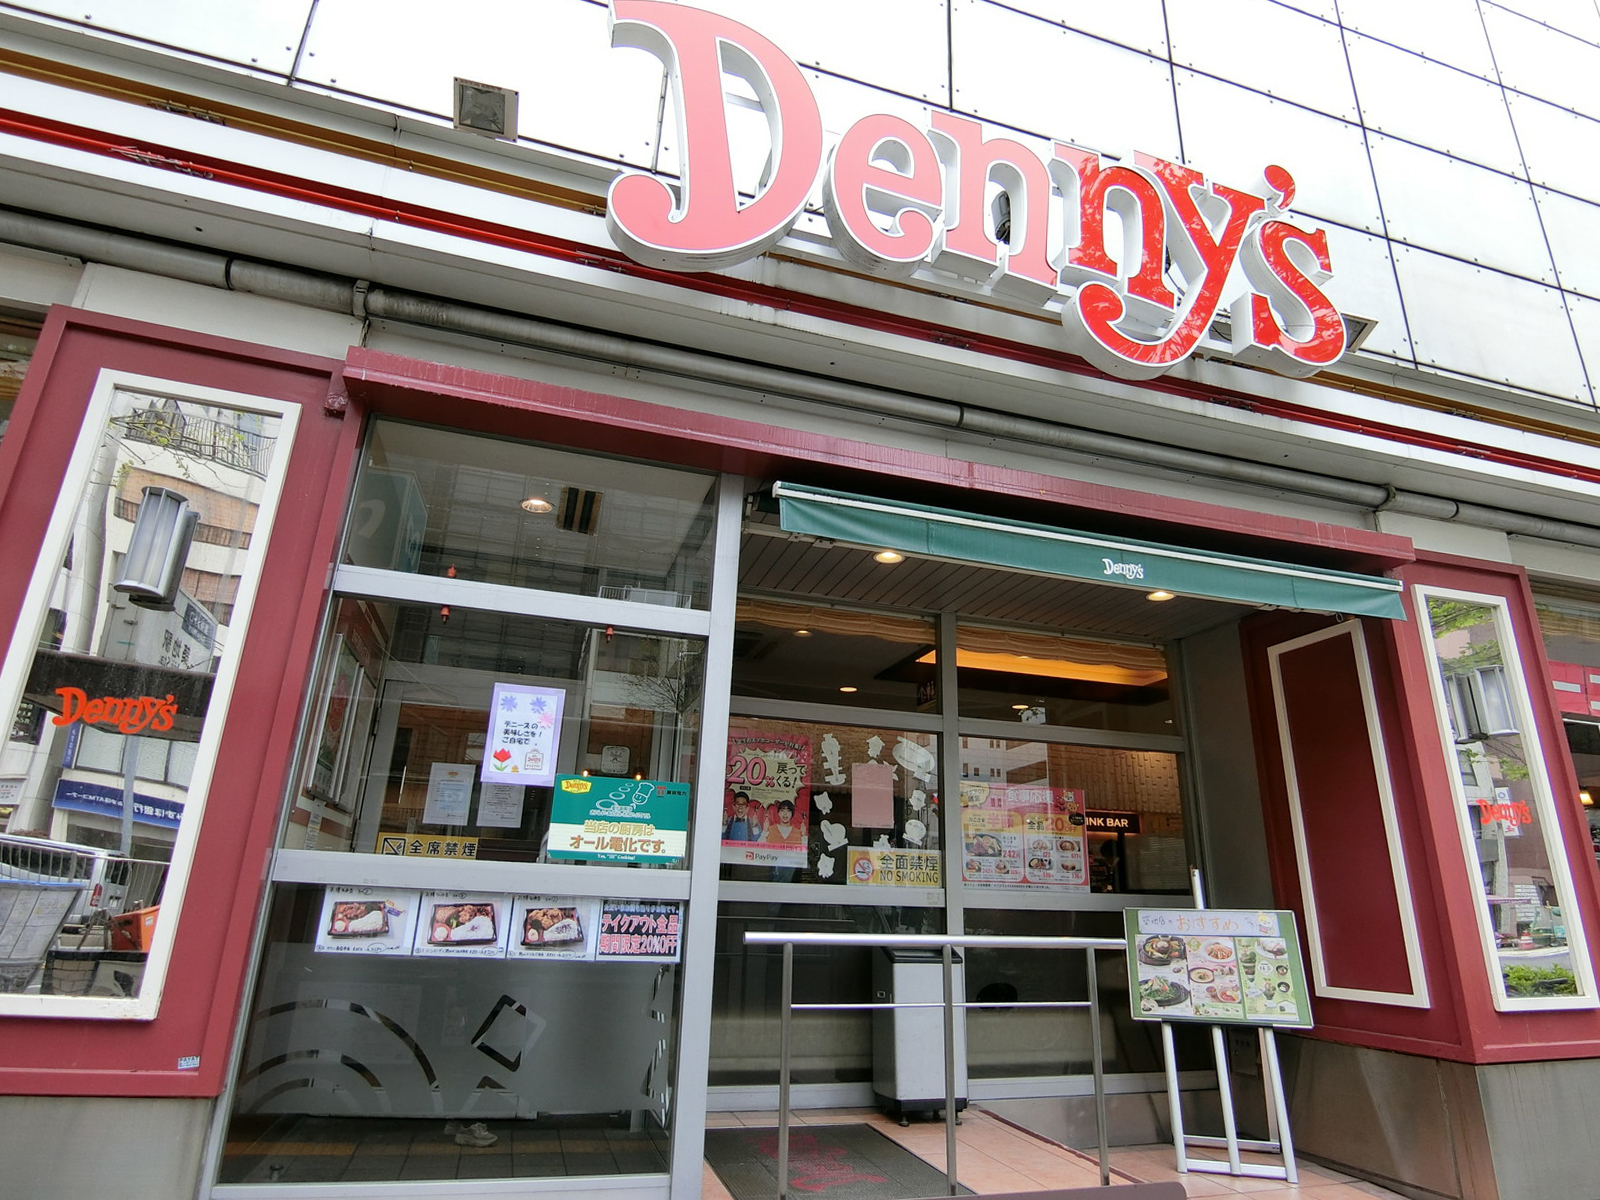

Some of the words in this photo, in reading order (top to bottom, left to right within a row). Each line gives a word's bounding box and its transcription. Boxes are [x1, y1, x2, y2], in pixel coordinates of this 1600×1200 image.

[606, 0, 1347, 376] Denny's
[1101, 558, 1144, 580] Denny's
[52, 686, 178, 734] Denny's
[726, 755, 775, 787] 20%
[776, 762, 807, 776] 戻って
[776, 776, 797, 788] くる!
[1476, 799, 1532, 826] Denny's
[583, 819, 655, 837] 当店の厨房は
[1027, 819, 1044, 831] 全品
[1106, 818, 1128, 828] BAR
[408, 839, 477, 857] 全席禁煙
[569, 835, 666, 854] オール電化です。
[755, 853, 778, 861] PayPay
[880, 854, 938, 871] 全面禁煙
[880, 870, 893, 882] NO
[896, 871, 939, 883] SMOKING
[601, 913, 678, 934] テイクアウト全品
[1176, 914, 1239, 932] おすすめ
[599, 933, 677, 955] 期間限定20%OFF
